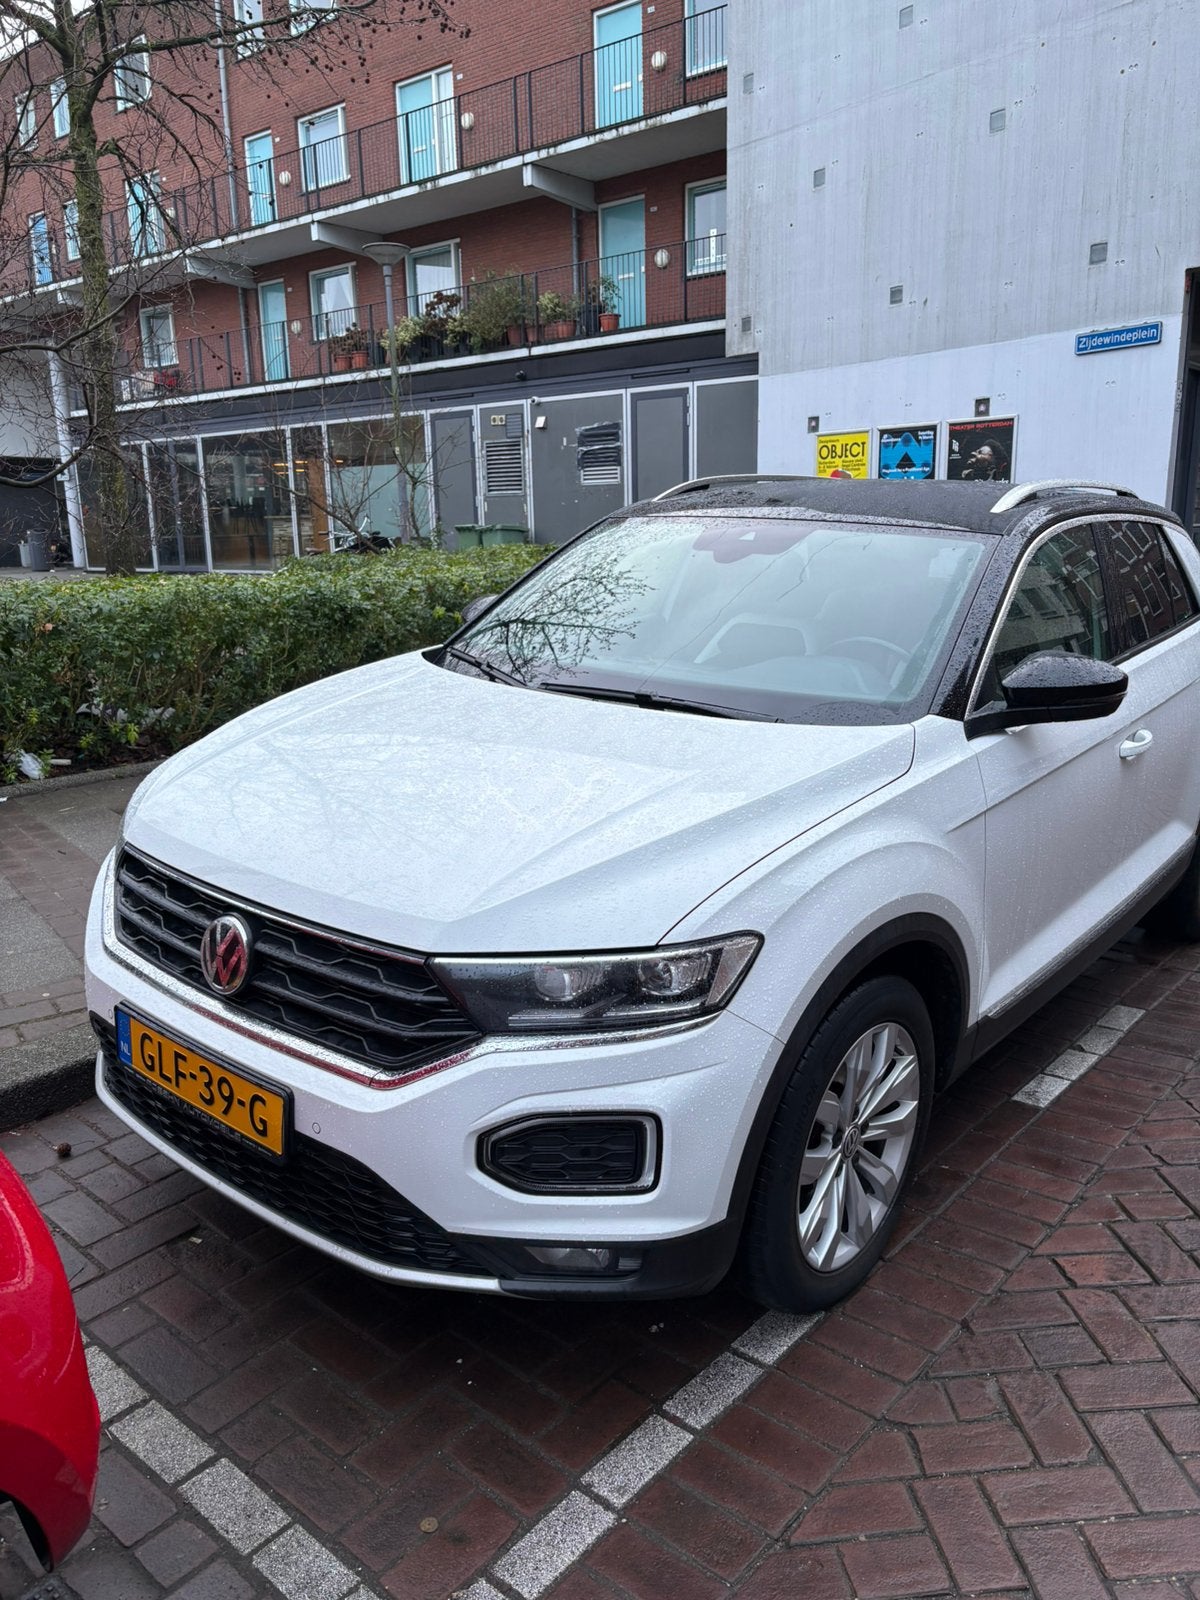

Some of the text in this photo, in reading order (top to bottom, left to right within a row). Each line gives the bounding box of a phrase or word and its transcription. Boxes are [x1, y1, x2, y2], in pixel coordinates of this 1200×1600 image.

[1078, 327, 1158, 350] Zijdewindeplein
[976, 420, 1013, 428] ROTTERDAM
[819, 441, 866, 460] OBJECT
[120, 1040, 131, 1057] NL
[140, 1031, 268, 1138] GLF-39-G
